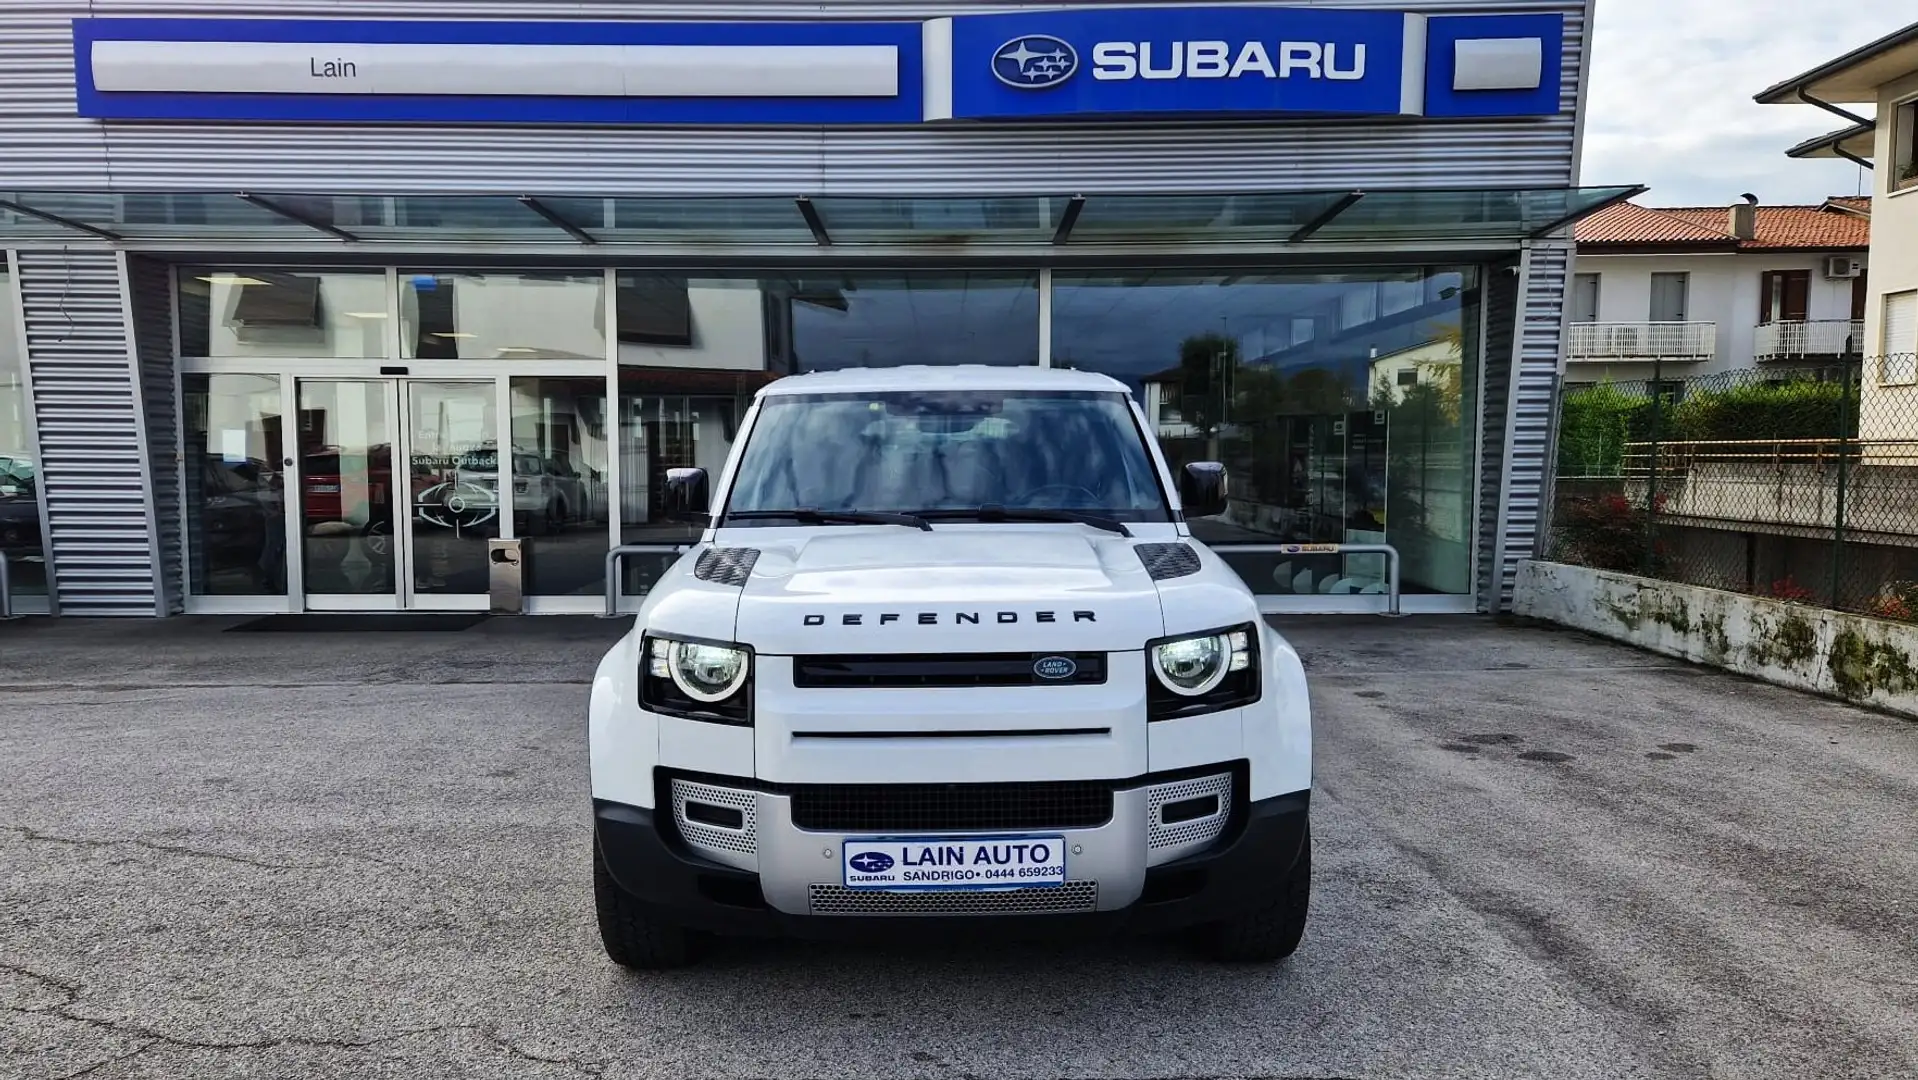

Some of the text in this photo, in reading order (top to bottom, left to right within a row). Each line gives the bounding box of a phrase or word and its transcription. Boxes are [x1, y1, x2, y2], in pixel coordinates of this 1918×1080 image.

[310, 56, 357, 77] Lain
[1092, 40, 1366, 80] SUBARU
[412, 456, 497, 465] Subaru Outback
[803, 611, 1096, 626] DEFENDER
[902, 844, 1050, 866] LAIN AUTO
[985, 867, 1015, 879] 0444
[1018, 865, 1064, 878] 659233
